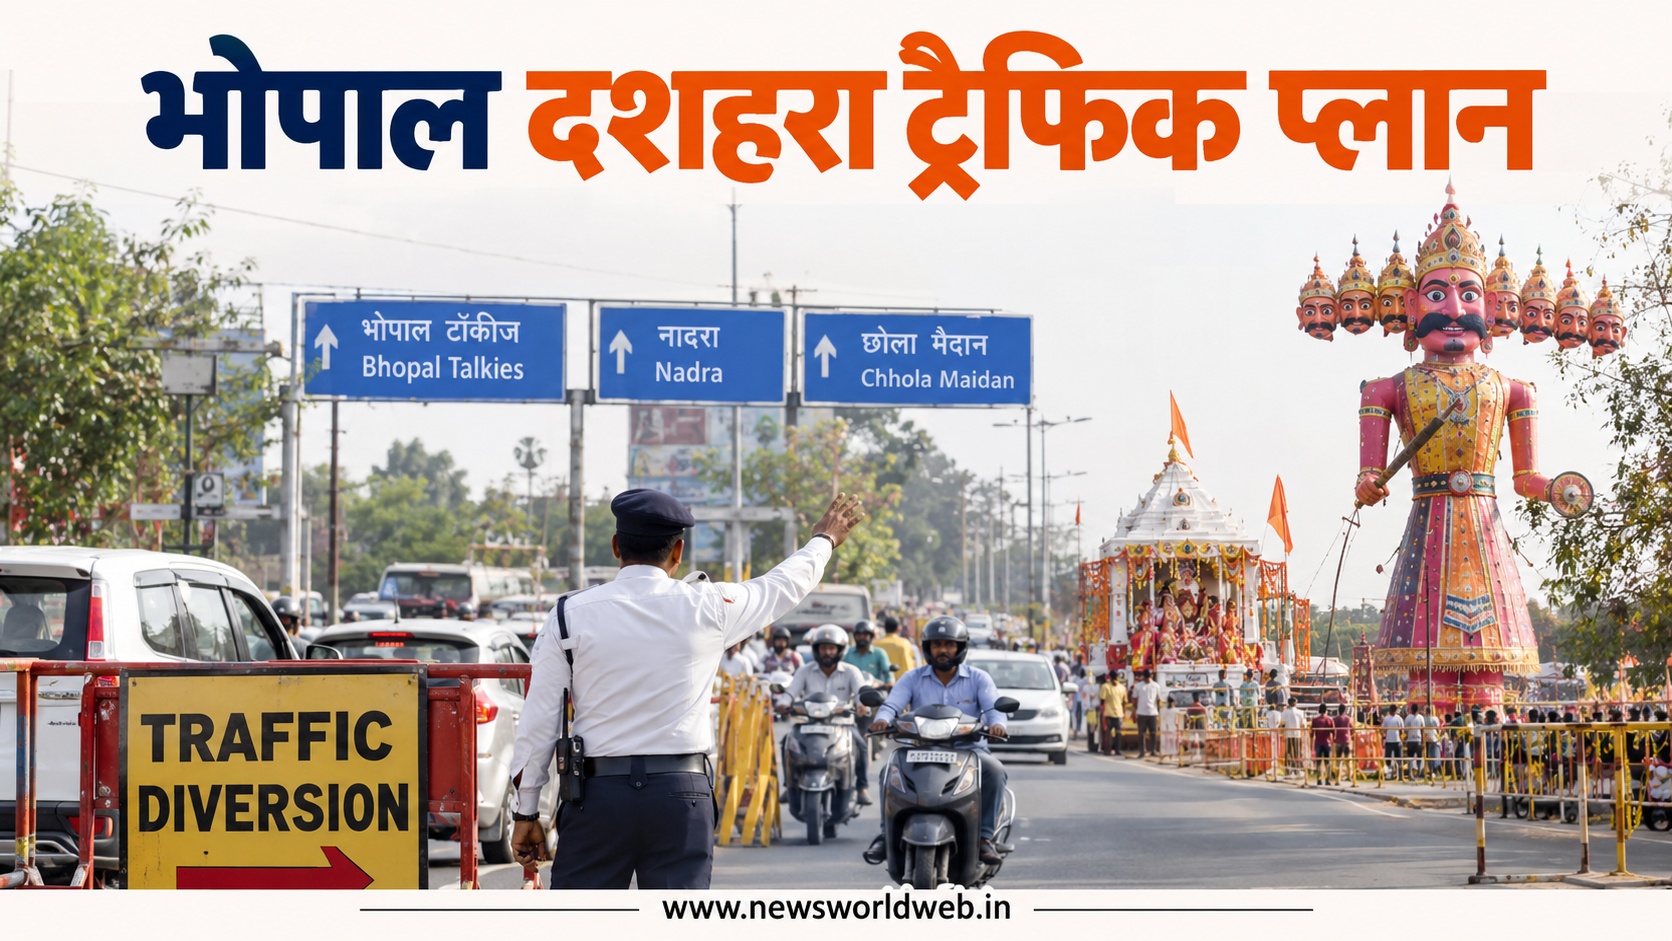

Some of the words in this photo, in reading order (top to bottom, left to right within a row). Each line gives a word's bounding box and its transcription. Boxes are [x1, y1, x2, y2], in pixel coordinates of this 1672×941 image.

[361, 310, 432, 343] भोपाल
[444, 311, 520, 344] टॉकीज
[657, 325, 720, 349] नादरा
[861, 325, 918, 355] छोला
[931, 325, 989, 357] मैदान
[362, 354, 441, 384] Bhopal
[448, 355, 525, 381] Talkies
[655, 360, 723, 384] Nadra
[861, 367, 932, 389] Chhola
[939, 369, 1015, 390] Maidan
[140, 710, 393, 763] TRAFFIC
[138, 782, 409, 832] DIVERSION
